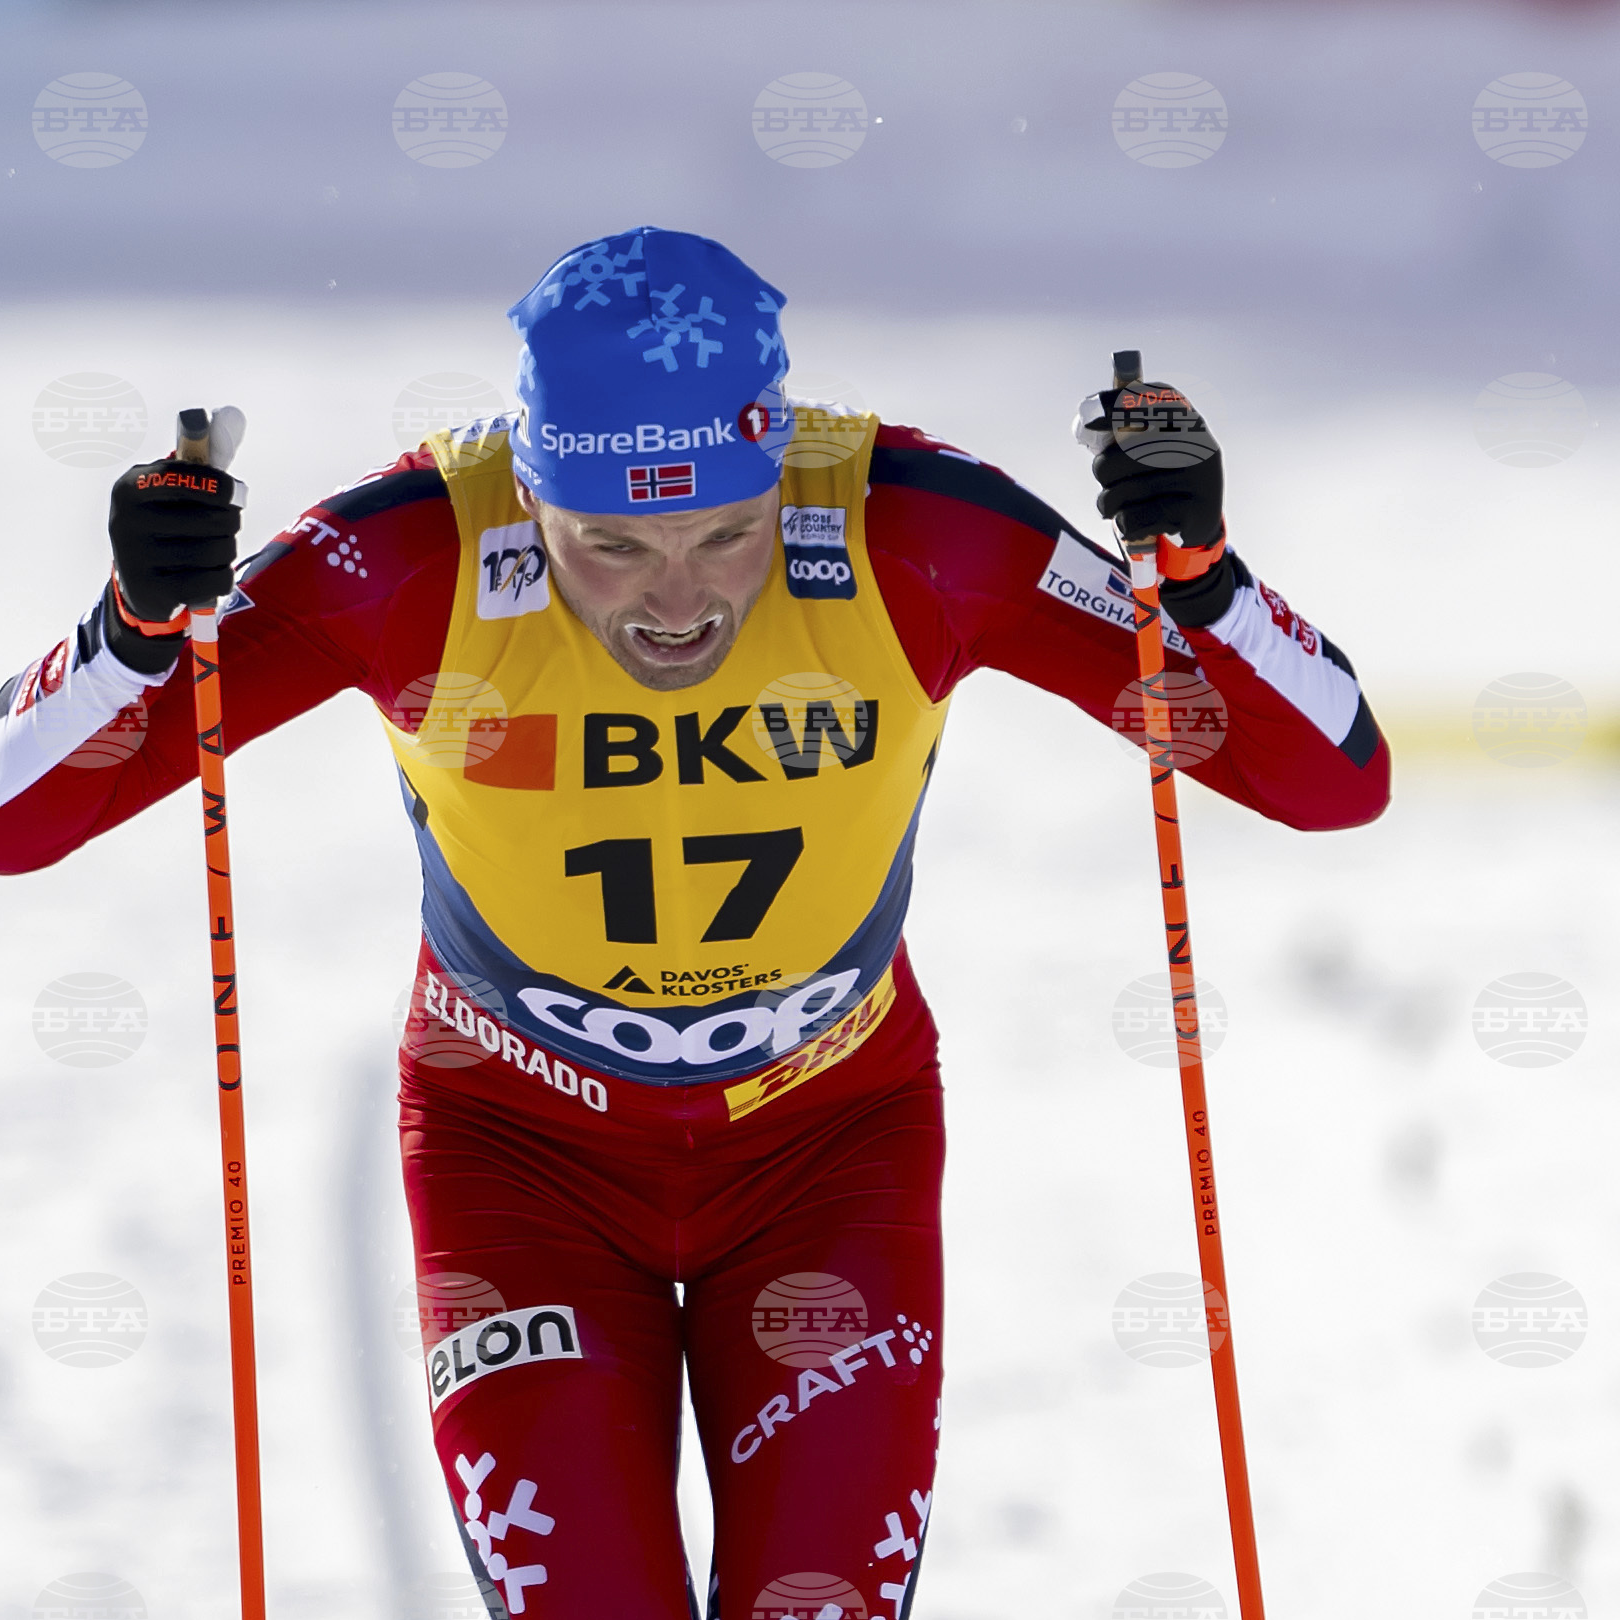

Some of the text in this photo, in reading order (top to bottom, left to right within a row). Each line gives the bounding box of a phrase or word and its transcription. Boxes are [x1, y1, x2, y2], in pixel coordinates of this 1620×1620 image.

[541, 417, 737, 459] SpareBank
[583, 700, 879, 790] BKW
[565, 826, 805, 945] 17
[424, 968, 608, 1113] ELDORADO
[661, 969, 783, 997] KLOSTERS
[228, 1161, 247, 1286] PREMIO 40
[1192, 1110, 1218, 1236] PREMIO 40
[731, 1329, 897, 1464] CRAFT
